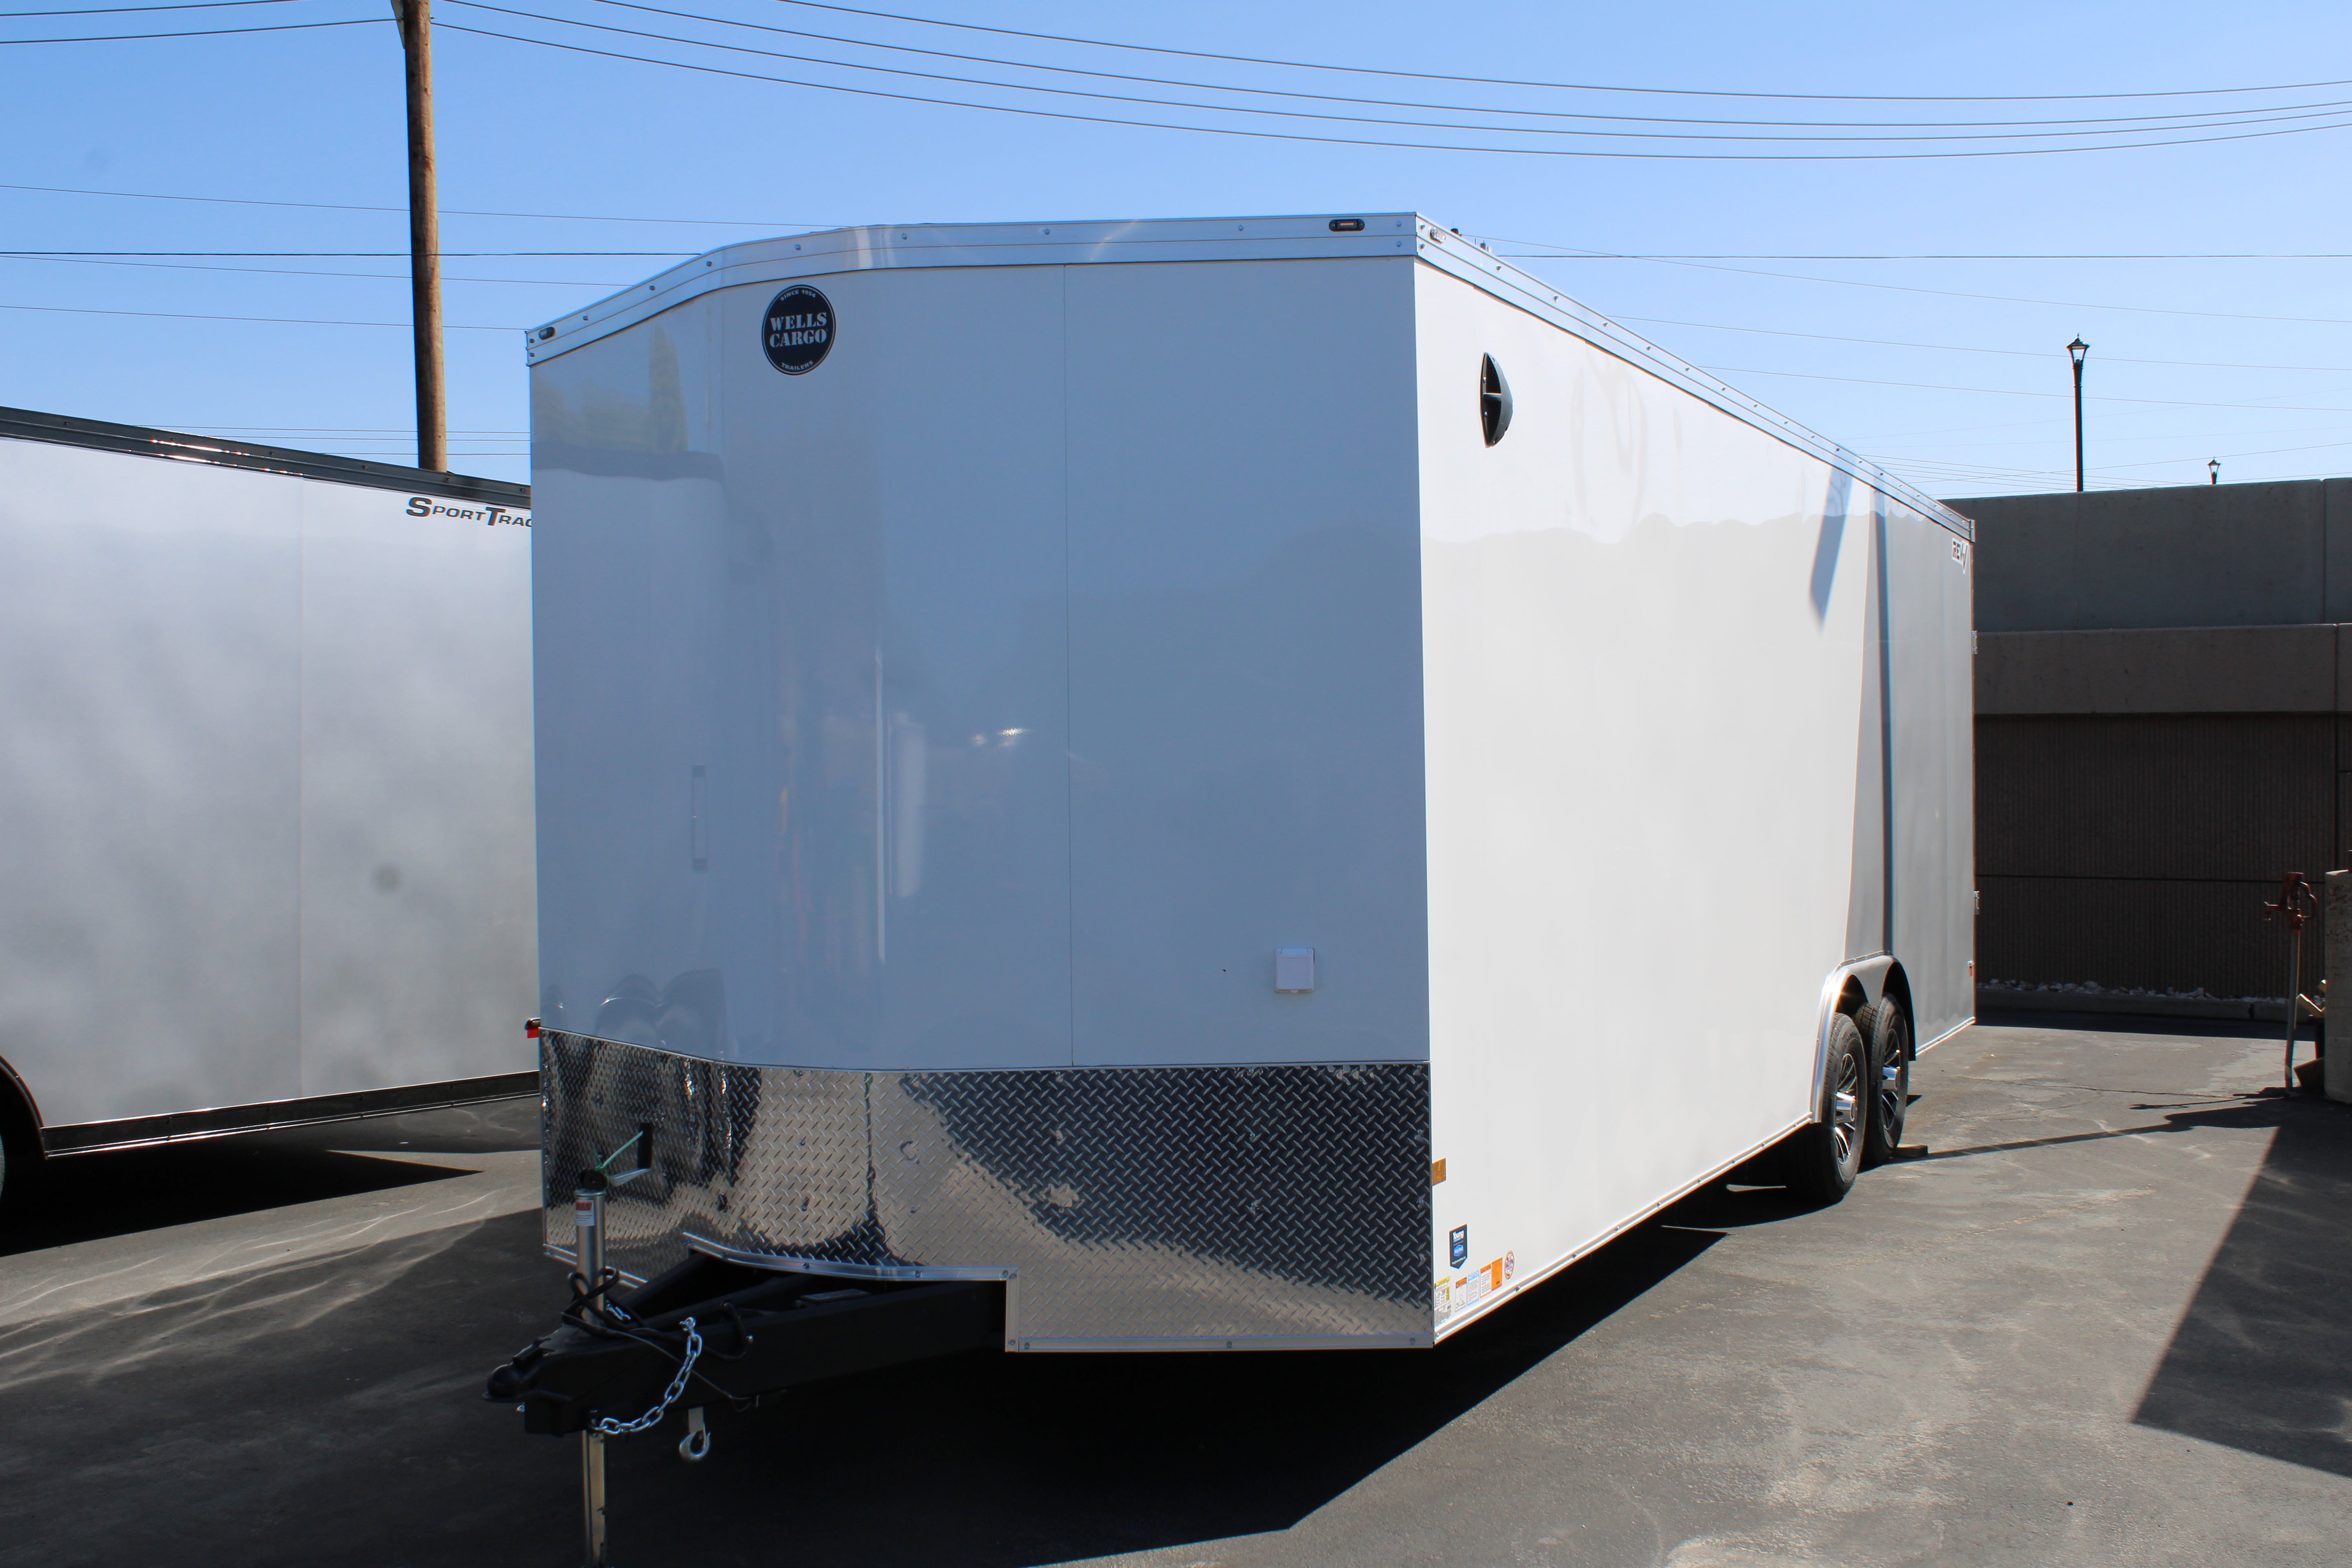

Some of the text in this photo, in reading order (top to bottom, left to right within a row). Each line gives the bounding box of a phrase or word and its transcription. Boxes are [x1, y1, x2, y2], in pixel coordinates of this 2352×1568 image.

[780, 290, 799, 301] SINCE
[770, 312, 826, 331] WELLS
[770, 329, 827, 347] CARGO
[781, 361, 813, 370] TRAILERS
[1468, 1271, 1479, 1281] NOTICE
